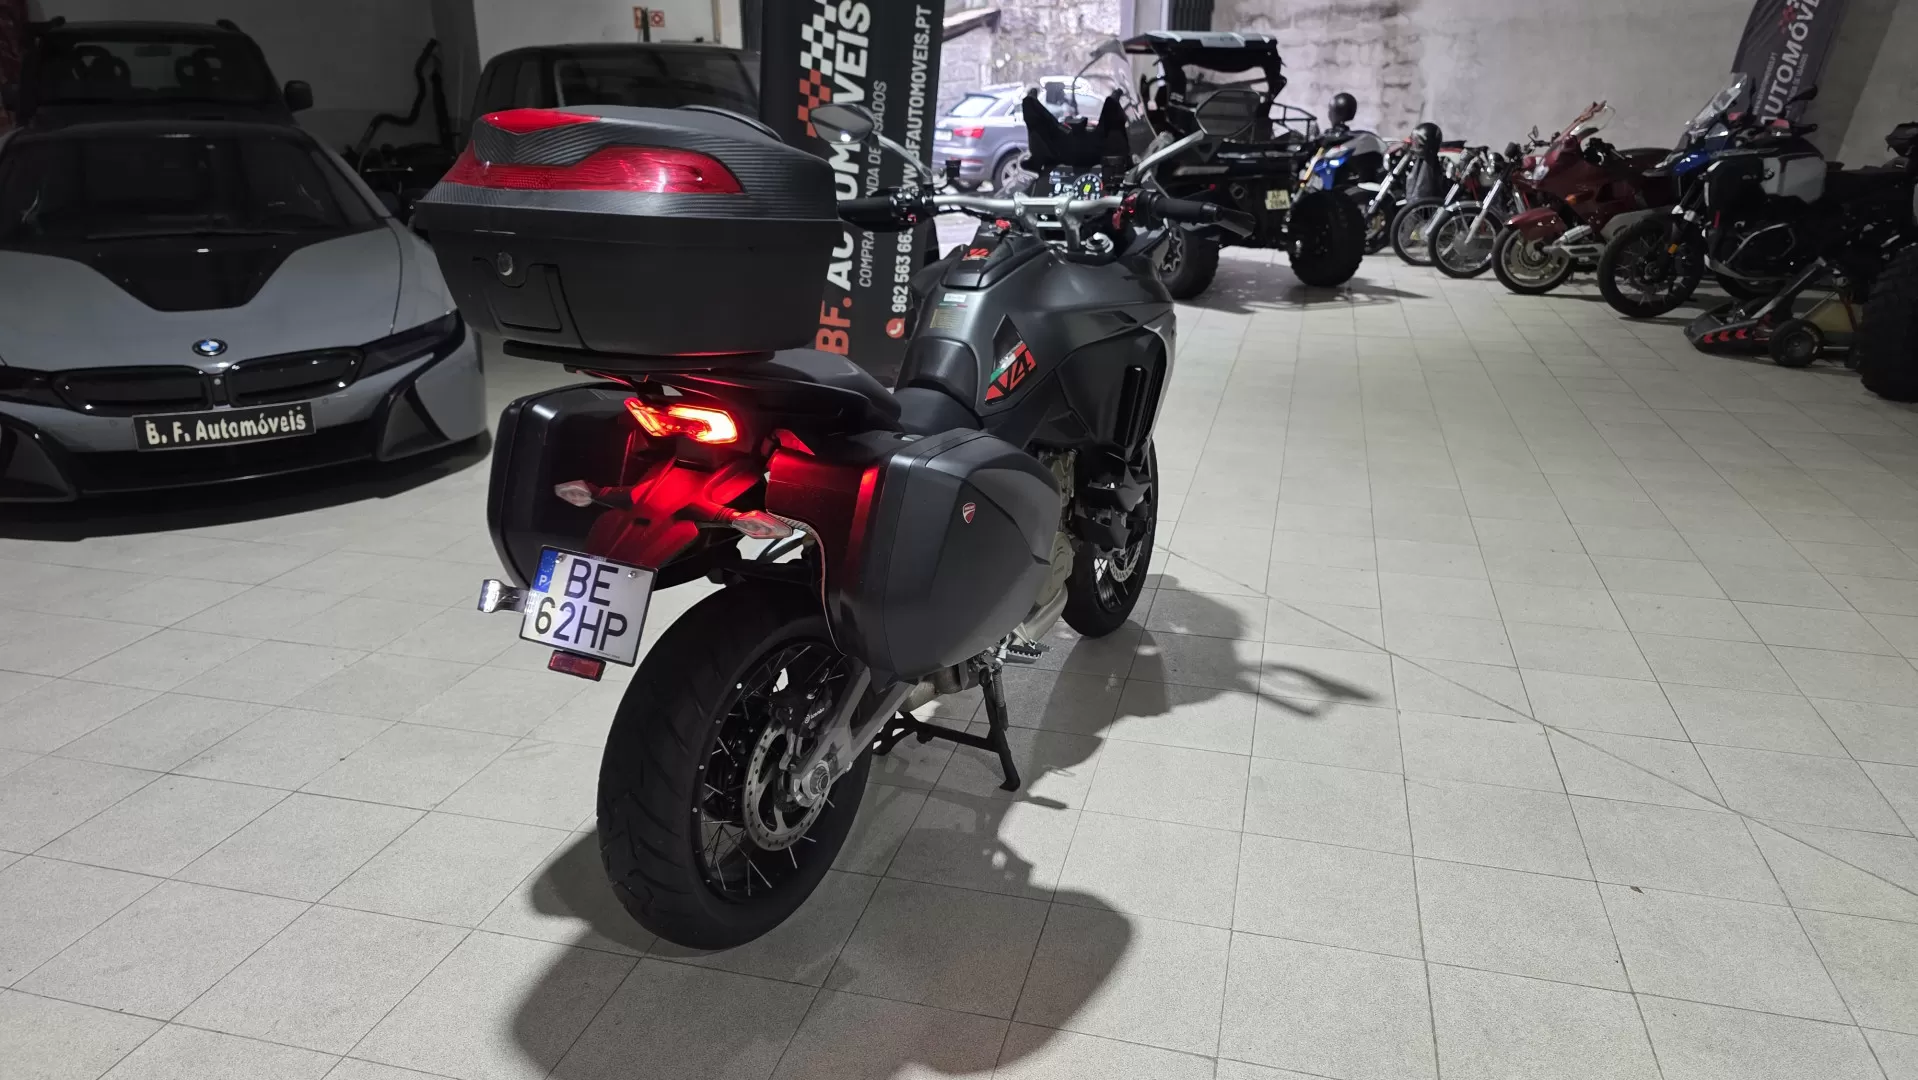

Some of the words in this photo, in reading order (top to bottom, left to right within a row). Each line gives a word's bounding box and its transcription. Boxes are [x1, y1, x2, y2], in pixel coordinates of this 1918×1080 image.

[871, 80, 887, 138] SADOS
[827, 0, 871, 291] AUOMVEIS
[868, 146, 882, 165] DE
[859, 231, 875, 288] COMPRA
[897, 228, 913, 253] 66
[894, 255, 911, 283] 563
[892, 285, 908, 313] 962
[815, 297, 852, 355] BF.
[146, 422, 168, 445] B.
[173, 421, 191, 443] F.
[196, 408, 306, 441] Automóveis
[539, 574, 547, 586] P
[564, 558, 619, 606] BE
[535, 597, 628, 650] 62HP
